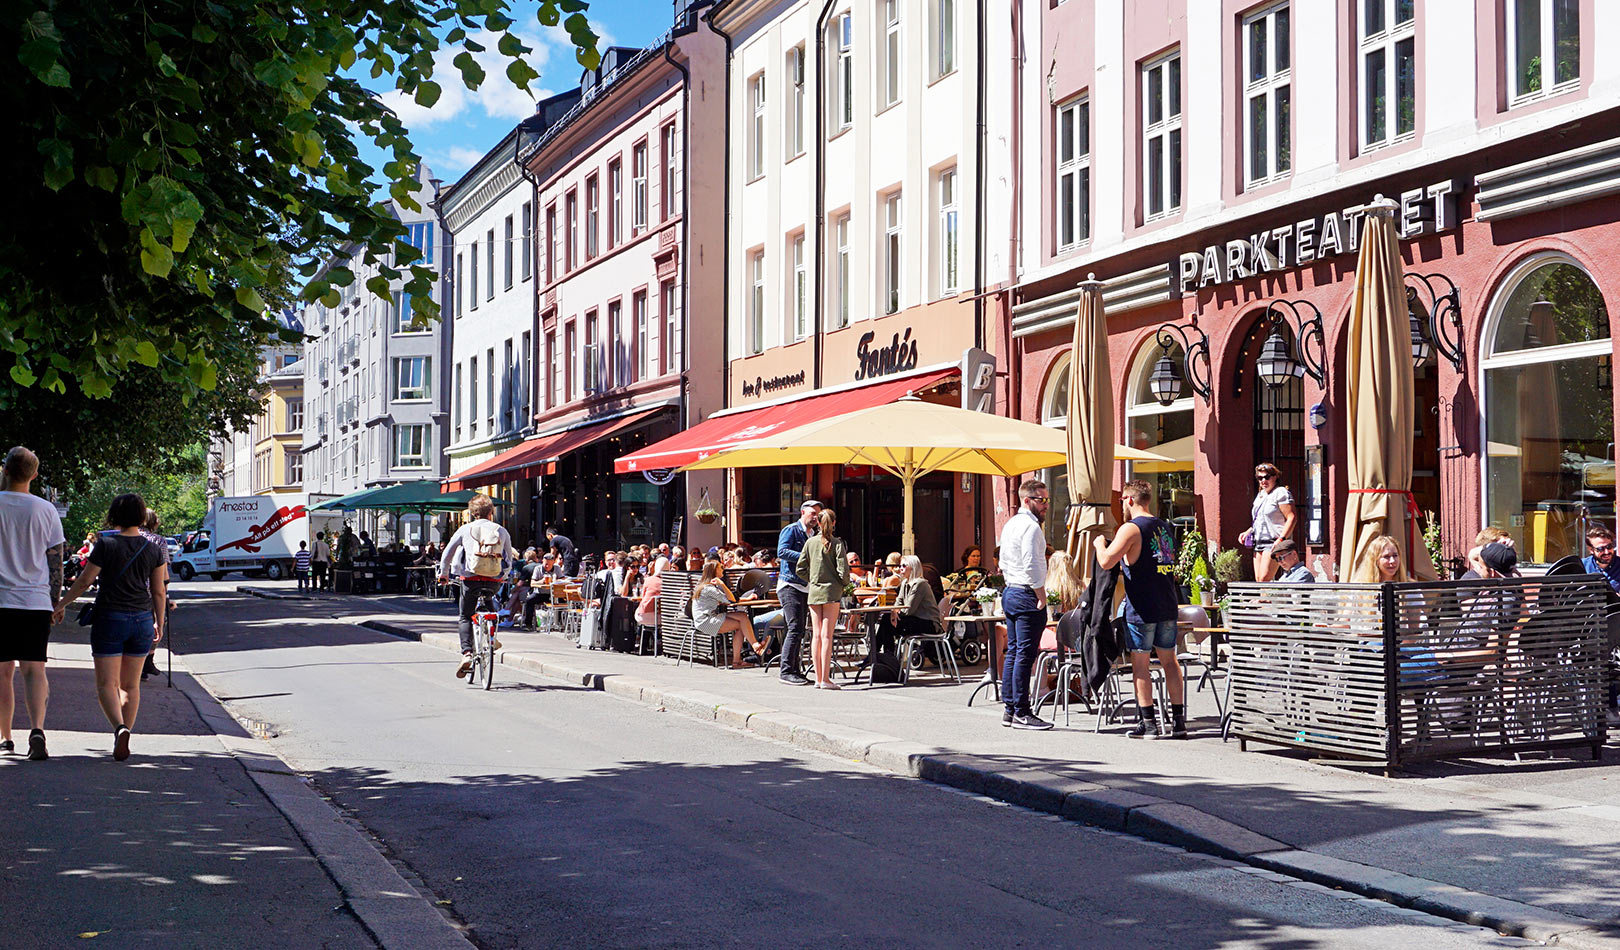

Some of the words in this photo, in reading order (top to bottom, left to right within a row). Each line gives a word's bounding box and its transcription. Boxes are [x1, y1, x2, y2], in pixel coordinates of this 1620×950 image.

[1179, 179, 1454, 293] PARKTEATET
[855, 327, 918, 381] Fontés
[742, 380, 754, 397] bar
[763, 369, 805, 392] restaurant
[972, 363, 994, 413] BA
